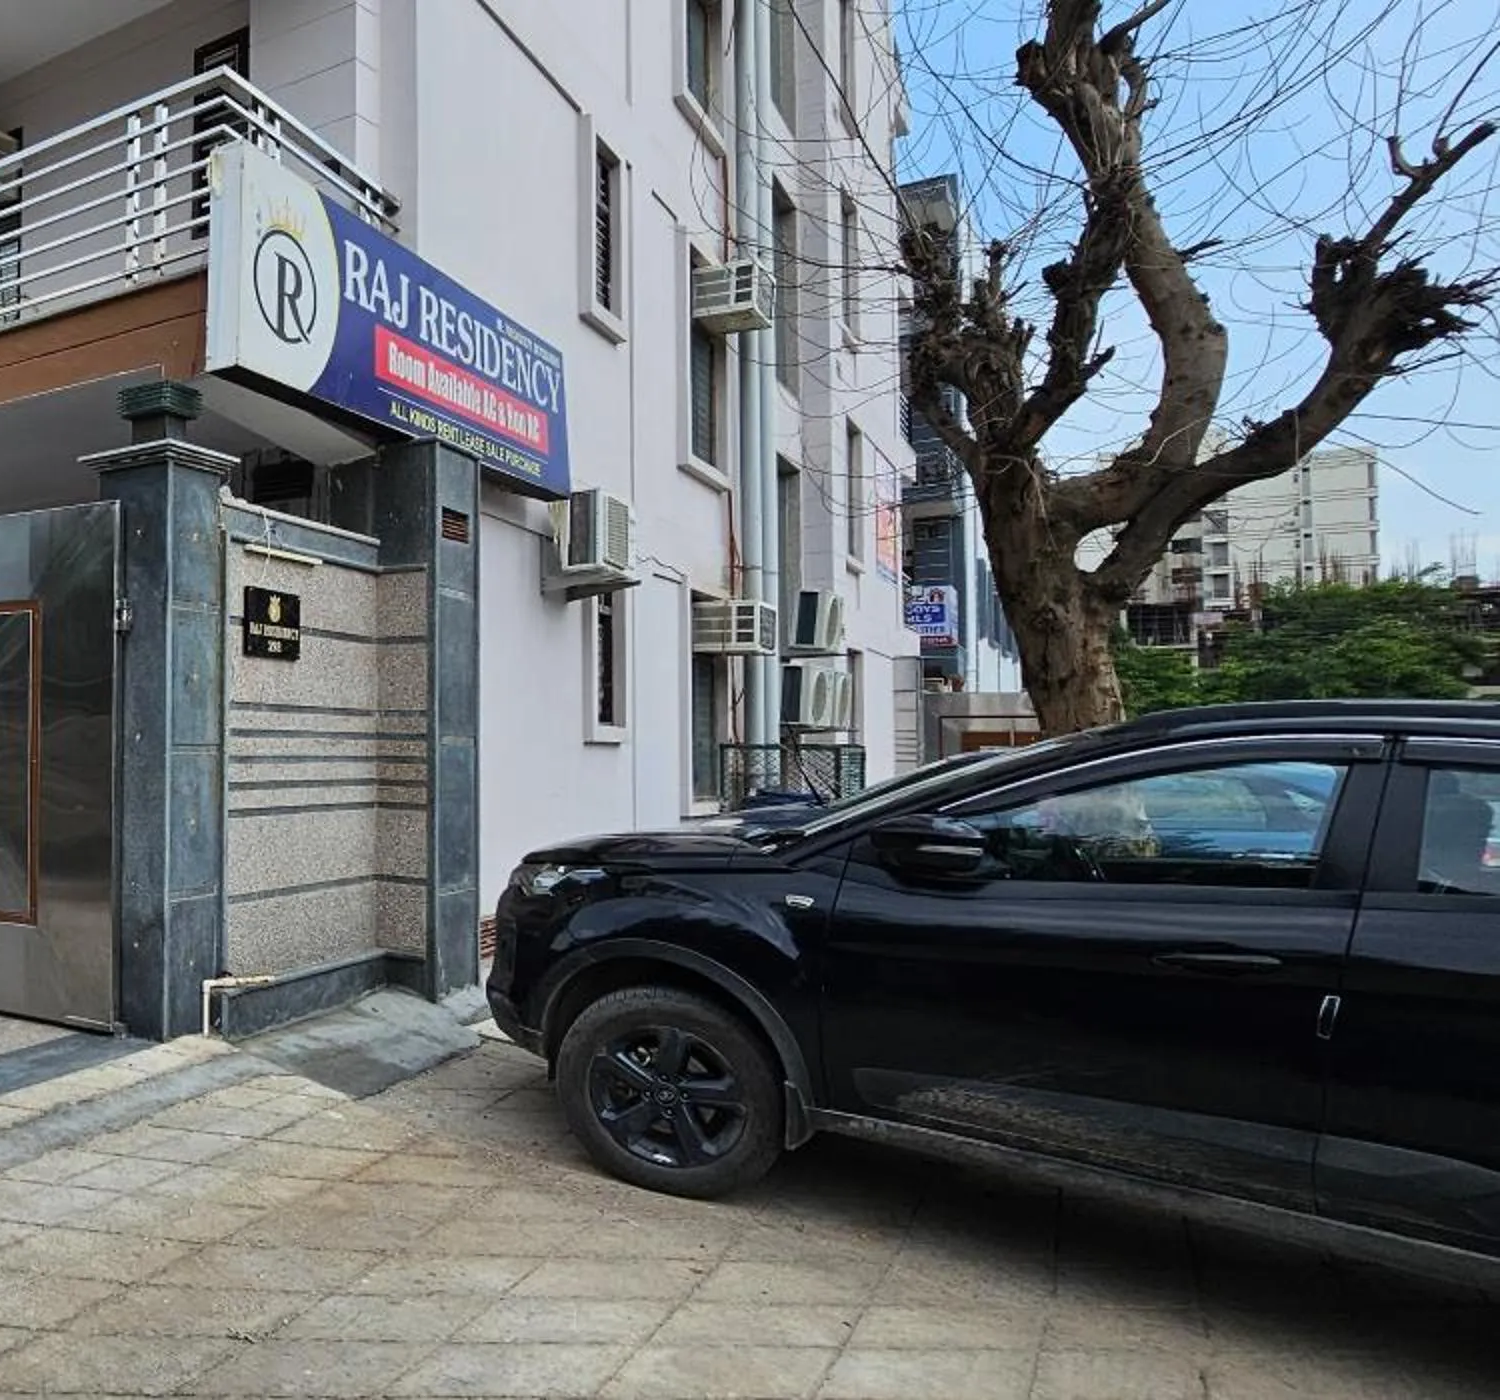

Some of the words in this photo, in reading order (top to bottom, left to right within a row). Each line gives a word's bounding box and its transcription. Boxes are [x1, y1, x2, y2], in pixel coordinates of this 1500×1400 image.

[344, 240, 409, 329] RAJ
[419, 285, 562, 413] RESIDENCY
[388, 341, 426, 389] Room
[428, 362, 481, 414] Available
[390, 400, 409, 422] ALL
[409, 407, 436, 433] KINDS
[249, 621, 262, 635] RAJ
